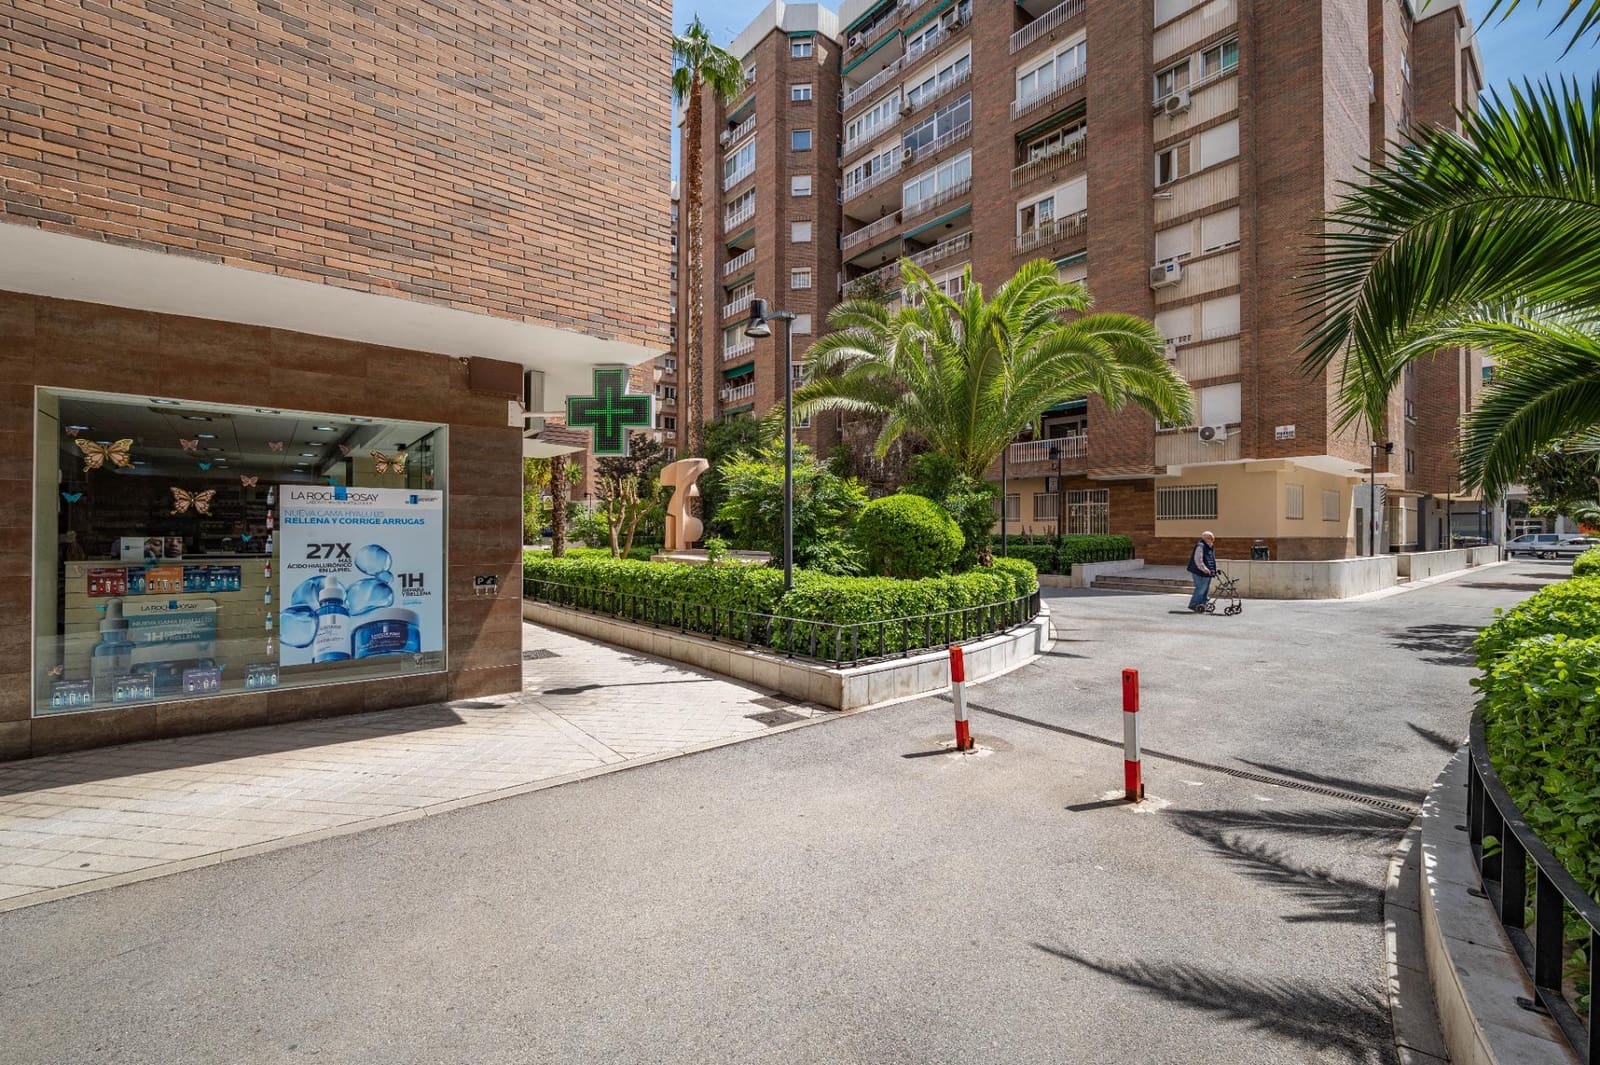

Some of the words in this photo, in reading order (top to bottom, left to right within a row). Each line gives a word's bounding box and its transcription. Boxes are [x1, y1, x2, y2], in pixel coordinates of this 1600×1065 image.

[291, 491, 305, 500] LA
[284, 517, 330, 525] RELLENA
[331, 517, 337, 525] Y
[339, 517, 381, 525] CORRIGE
[382, 517, 425, 525] ARRUGAS
[306, 543, 352, 560] 27X
[397, 573, 424, 588] 1H
[143, 632, 164, 642] 1H
